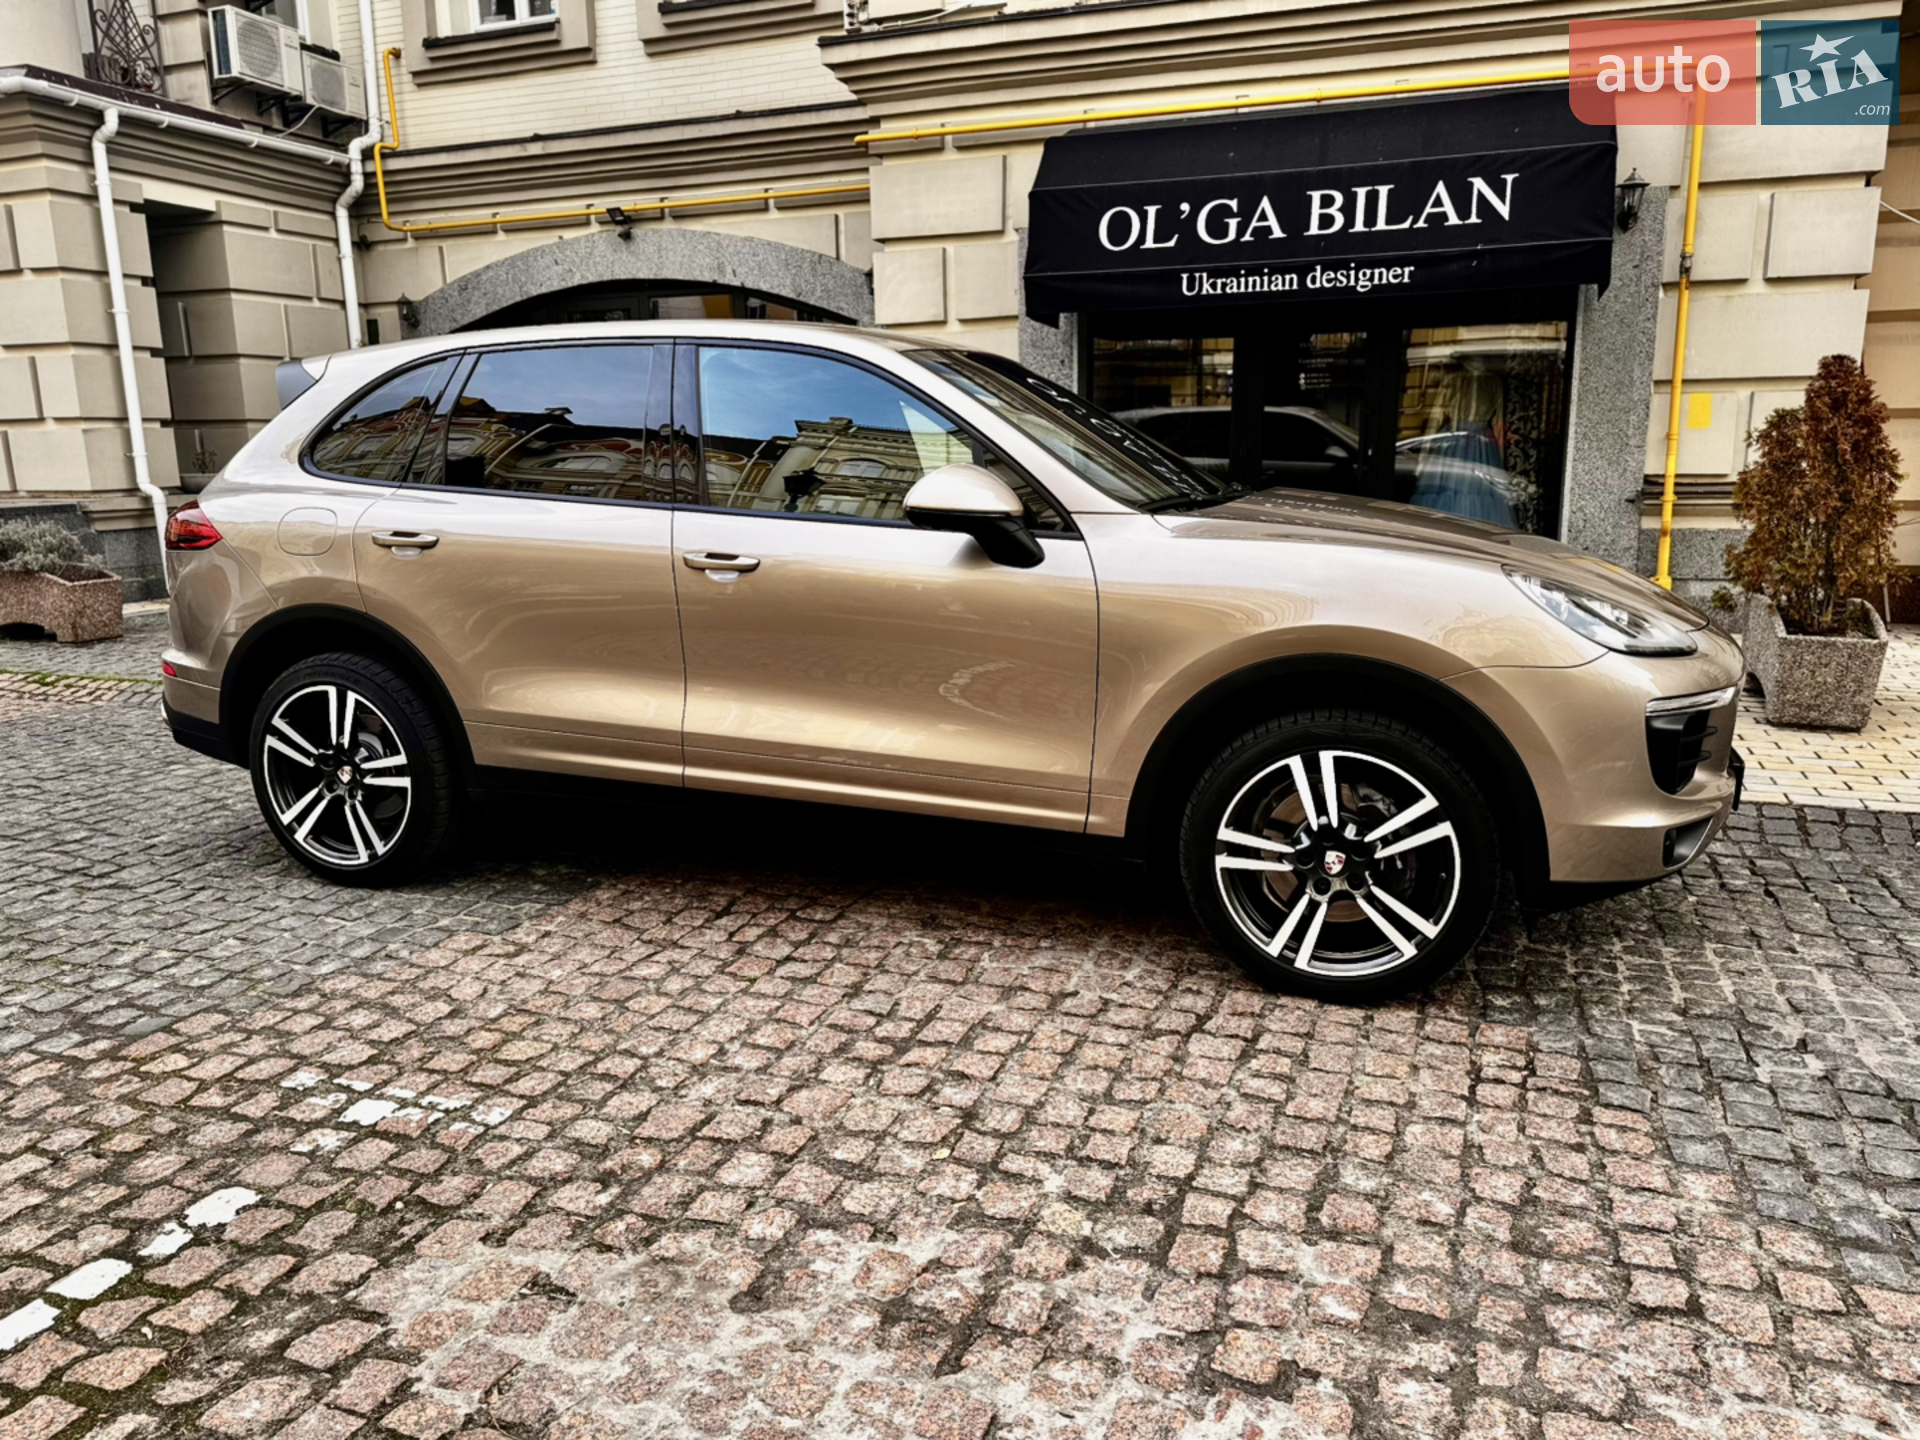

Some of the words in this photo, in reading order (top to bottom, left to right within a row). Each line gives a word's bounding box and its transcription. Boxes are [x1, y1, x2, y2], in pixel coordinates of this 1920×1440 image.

[1303, 173, 1520, 236] BILAN
[1180, 271, 1298, 296] Ukrainian
[1306, 262, 1415, 292] designer
